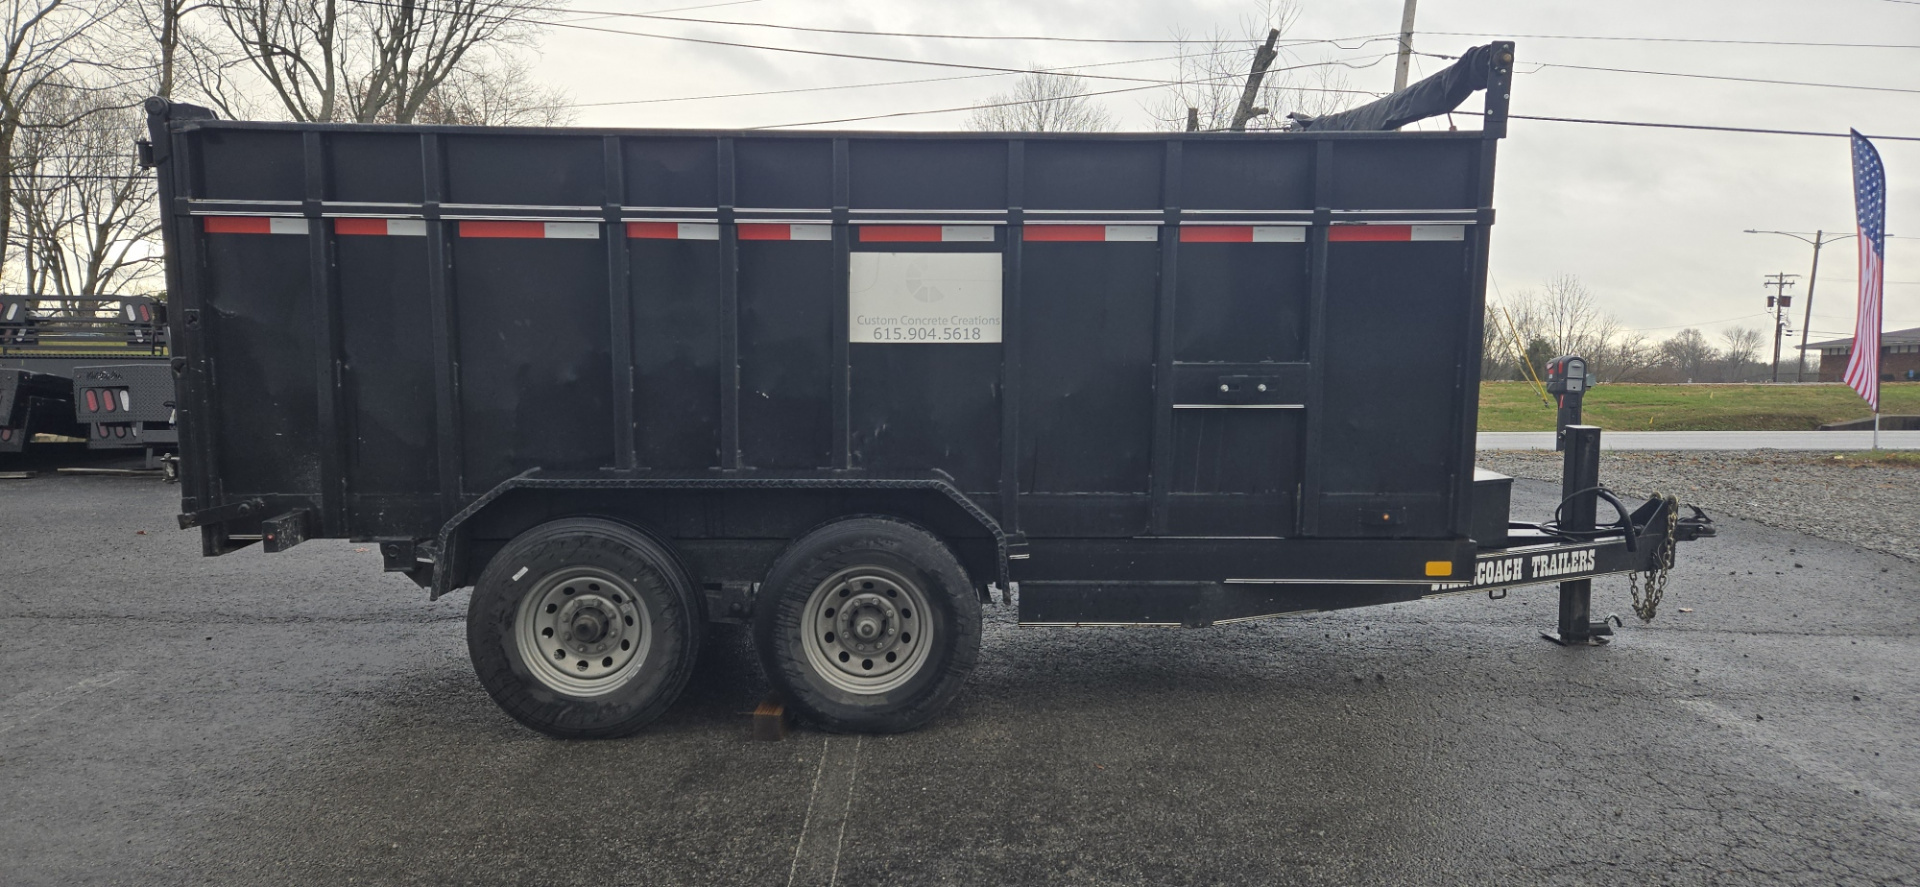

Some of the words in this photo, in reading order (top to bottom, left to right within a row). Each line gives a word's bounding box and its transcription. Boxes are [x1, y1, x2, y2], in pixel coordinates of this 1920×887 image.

[857, 315, 897, 325] Custom
[900, 315, 948, 325] Concrete
[951, 315, 1000, 325] Creations
[873, 327, 981, 340] 615.904.5618
[1532, 549, 1596, 578] TRAILERS
